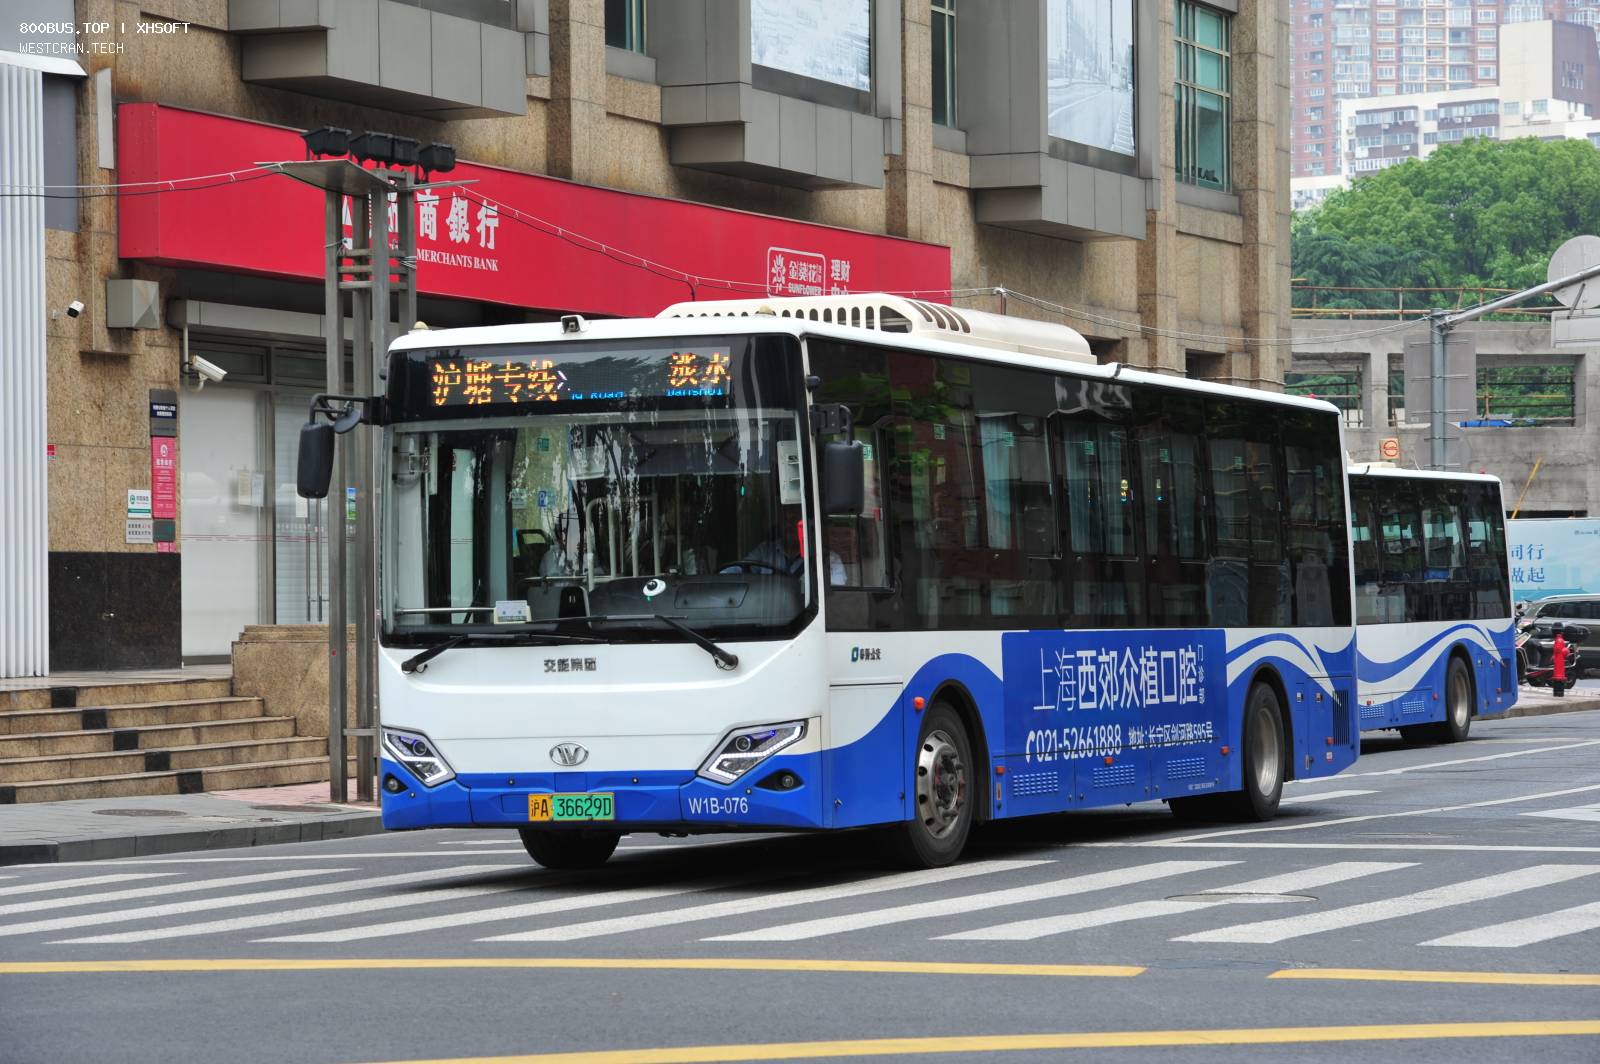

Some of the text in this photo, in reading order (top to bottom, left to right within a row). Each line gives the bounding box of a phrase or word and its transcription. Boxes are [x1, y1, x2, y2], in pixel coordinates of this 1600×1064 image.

[416, 248, 499, 272] MERCHANTS BANK
[830, 259, 850, 282] 理财
[1033, 645, 1198, 712] 上海西郊众植口腔
[1036, 723, 1122, 763] 021-52661888
[531, 797, 612, 817] 沪A 36629D
[688, 797, 749, 815] W1B-076
